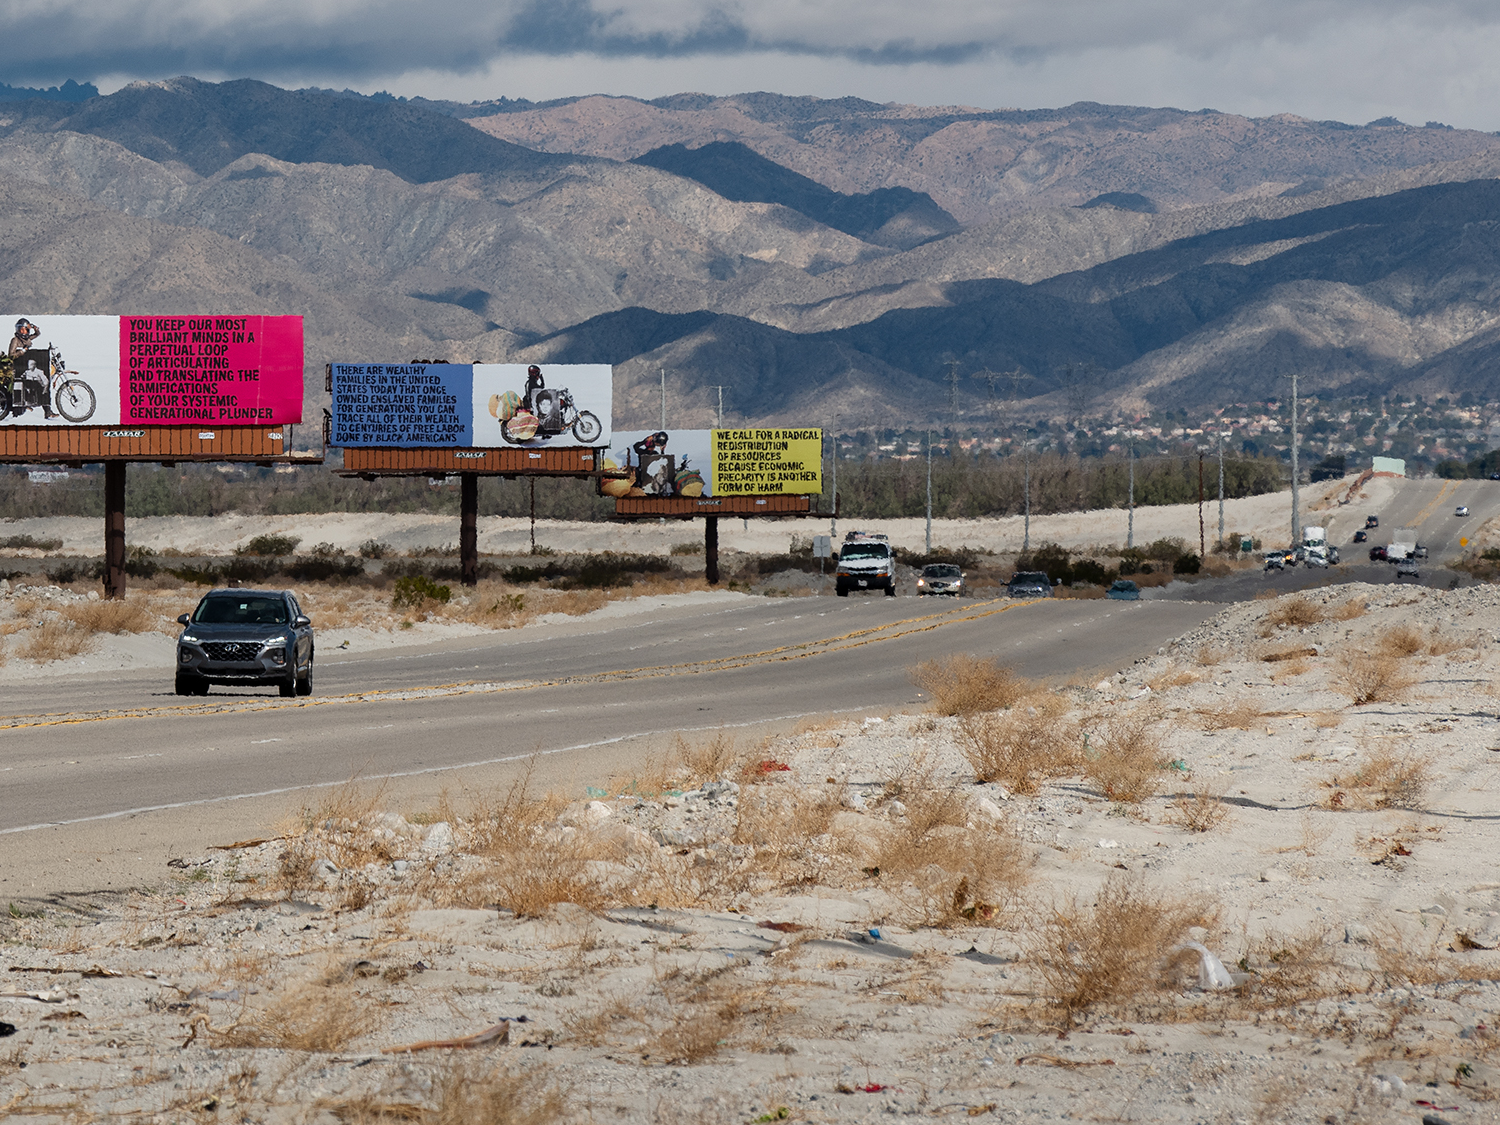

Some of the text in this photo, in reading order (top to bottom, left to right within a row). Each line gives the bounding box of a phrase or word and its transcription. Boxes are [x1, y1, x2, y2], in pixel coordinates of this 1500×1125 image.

[130, 319, 247, 331] YOU KEEP OUR MOST
[130, 332, 255, 343] BRILLIANT MINDS IN A
[130, 345, 228, 356] PERPETUAL LOOP
[129, 357, 229, 368] OF ARTICULATING
[336, 366, 426, 375] THERE ARE WEALTHY
[129, 370, 259, 381] AND TRANSLATING THE
[337, 376, 440, 384] FAMILIES IN THE UNITED
[130, 383, 218, 394] RAMIFICATIONS
[337, 385, 446, 394] STATES TODAY THAT ONCE
[130, 395, 237, 406] OF YOUR SYSTEMIC
[337, 395, 457, 404] OWNED ENSLAVED FAMILIES
[130, 408, 273, 419] GENERATIONAL PLUNDER
[337, 405, 455, 413] FOR GENERATIONS YOU CAN
[337, 414, 459, 423] TRACE ALL OF THEIR WEALTH
[337, 424, 465, 433] TO CENTURIES OF FREE LABOR
[336, 433, 457, 442] DONE BY BLACK AMERICANS
[717, 431, 819, 440] WE CALL FOR A RADICAL
[718, 442, 788, 450] REDISTRIBUTION
[718, 452, 781, 461] OF RESOURCES
[718, 463, 804, 471] BECAUSE ECONOMIC
[718, 472, 817, 481] PRECARITY IS ANOTHER
[718, 483, 783, 492] FORM OF HARM
